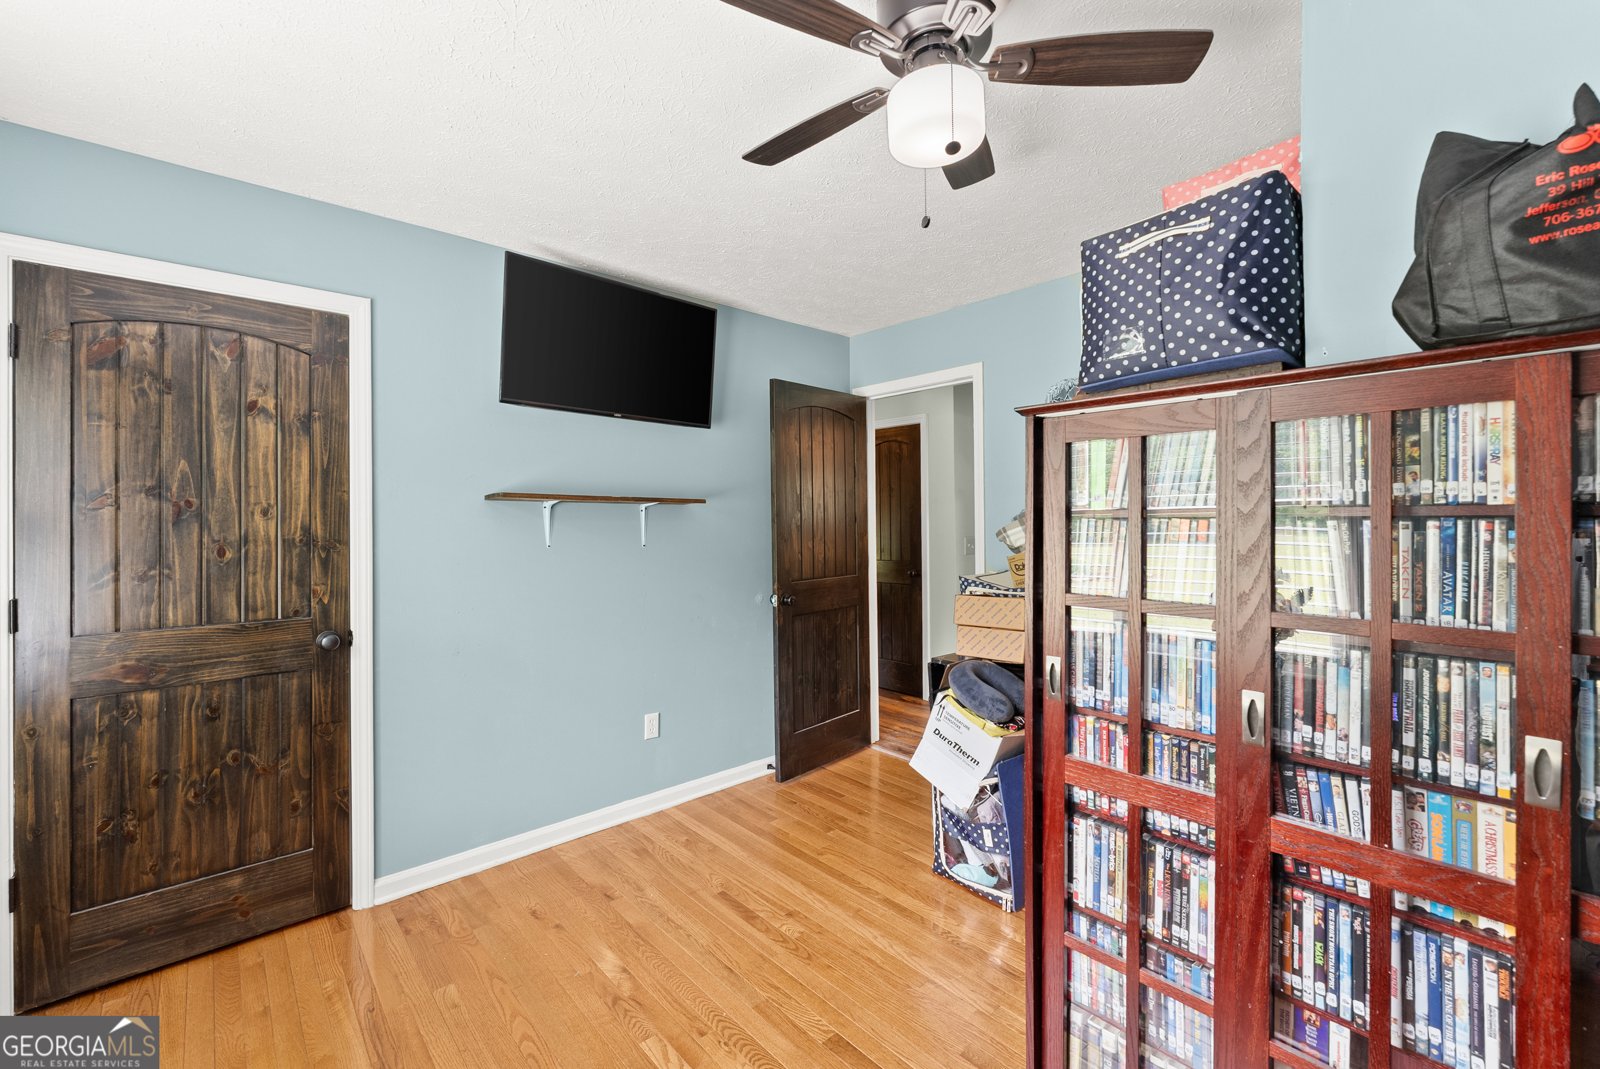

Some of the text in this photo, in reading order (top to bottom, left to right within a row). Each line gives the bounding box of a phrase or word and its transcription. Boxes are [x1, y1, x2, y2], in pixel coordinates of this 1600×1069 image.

[1535, 171, 1566, 187] Eric
[1548, 184, 1567, 198] 39
[1401, 546, 1410, 600] TAKEN
[1415, 562, 1424, 601] TAKEN
[1442, 571, 1454, 614] AVATAR
[1403, 679, 1415, 735] BROKEN TRAIL
[1422, 668, 1430, 758] JOURNEY CENTER EARTH
[932, 727, 980, 766] DuraTherm
[1300, 794, 1308, 809] FRIED
[1406, 818, 1427, 851] GREASE
[1429, 942, 1437, 984] POSEIDON
[1445, 969, 1453, 979] IN
[1445, 980, 1453, 995] THE
[1445, 997, 1454, 1013] LINE
[1445, 1014, 1454, 1025] OF
